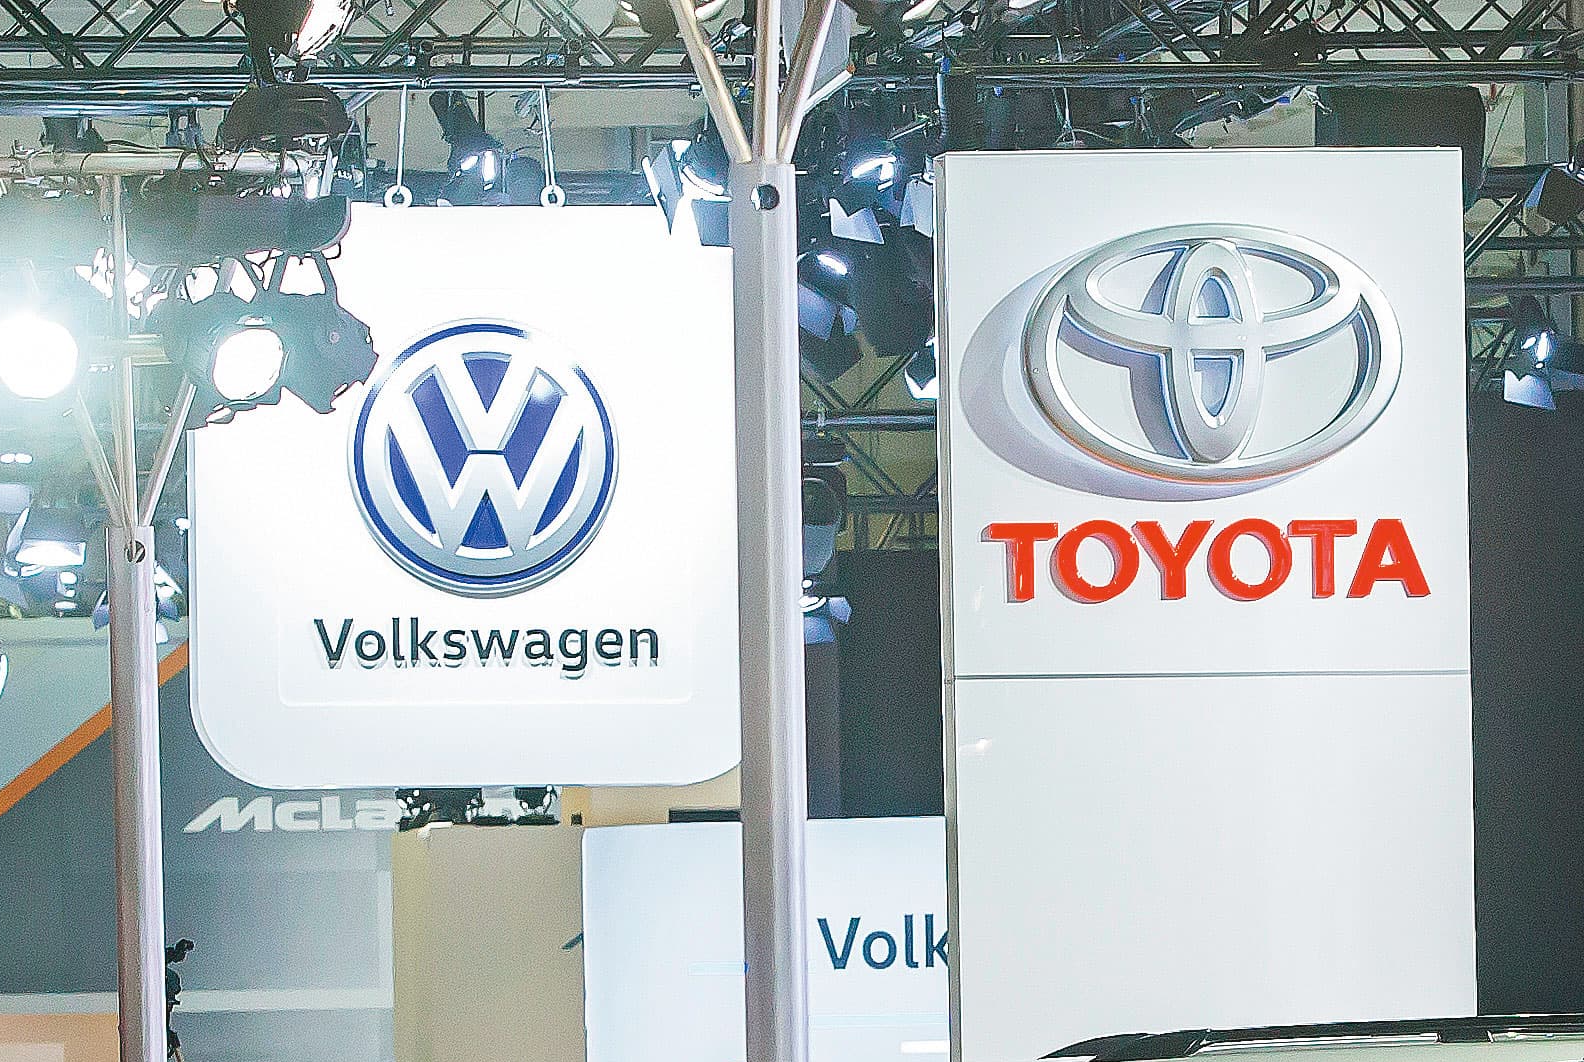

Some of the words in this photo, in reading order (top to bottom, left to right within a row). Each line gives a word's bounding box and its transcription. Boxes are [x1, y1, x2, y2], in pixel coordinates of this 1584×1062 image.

[981, 517, 1431, 603] TOYOTA
[312, 616, 660, 678] Volkswagen
[817, 914, 949, 969] Volk
